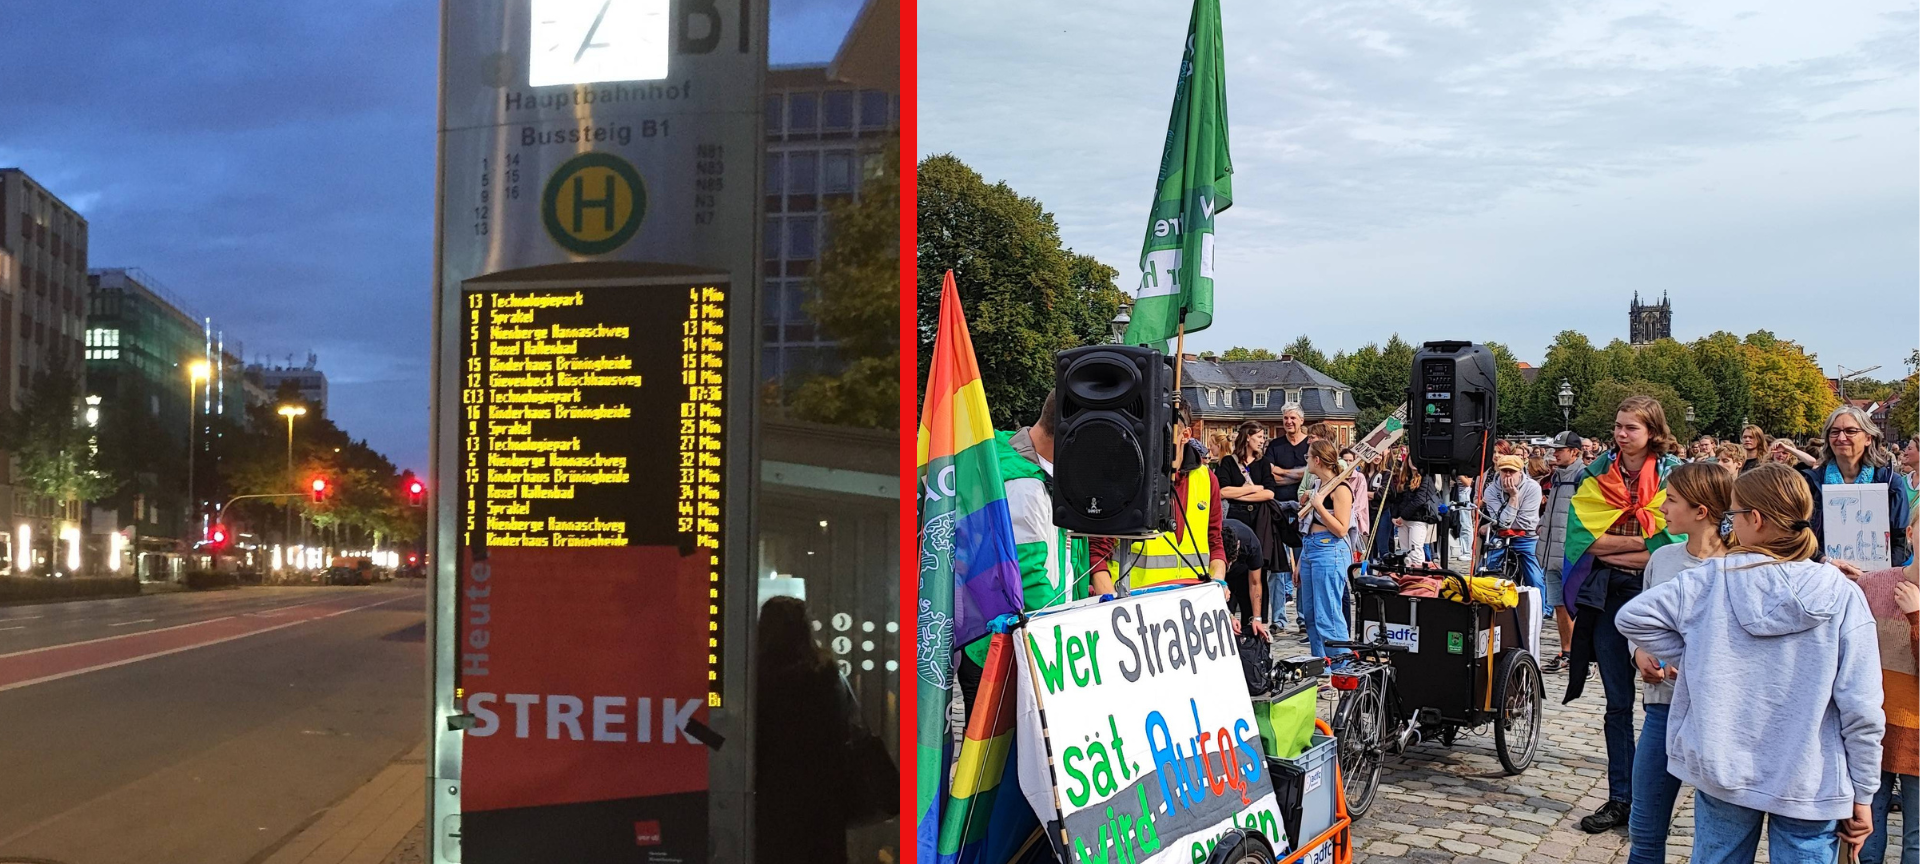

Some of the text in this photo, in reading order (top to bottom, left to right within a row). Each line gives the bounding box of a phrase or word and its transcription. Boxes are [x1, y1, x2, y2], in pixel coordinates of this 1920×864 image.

[505, 81, 692, 111] Hauptbahnhof
[521, 119, 671, 147] Bussteig B1
[483, 158, 488, 171] 1
[505, 153, 520, 167] 14
[482, 173, 489, 187] 5
[505, 169, 520, 183] 15
[504, 186, 519, 199] 16
[475, 206, 489, 219] 12
[573, 175, 615, 233] H
[474, 222, 488, 236] 13
[469, 287, 724, 309] 13 Technologiepark 4 Min
[471, 310, 479, 324] 9
[490, 309, 534, 325] Sprakel
[702, 304, 723, 319] Min
[471, 326, 478, 340] 5
[490, 325, 548, 341] Nienberge
[683, 321, 697, 335] 13
[702, 320, 723, 335] Min
[471, 342, 477, 356] 1
[683, 337, 697, 352] 14
[701, 337, 723, 351] Min
[468, 357, 481, 371] 15
[489, 356, 552, 371] Kinderhaus
[683, 353, 697, 368] 15
[701, 353, 722, 368] Min
[468, 373, 481, 388] 12
[701, 370, 722, 385] Min
[463, 389, 484, 404] E13
[489, 388, 581, 405] Technologiepark
[489, 404, 551, 420] Kinderhaus
[700, 403, 721, 418] Min
[469, 419, 721, 437] 9 Sprakel 25 Min
[466, 437, 480, 451] 13
[488, 436, 581, 452] Technologiepark
[699, 436, 721, 451] Min
[469, 452, 476, 467] 5
[488, 453, 545, 469] Nienberge
[699, 452, 720, 467] Min
[466, 468, 479, 483] 15
[487, 469, 550, 484] Kinderhaus
[680, 468, 694, 483] 33
[698, 468, 720, 483] Min
[468, 484, 474, 498] 1
[698, 485, 720, 499] Min
[468, 500, 475, 515] 9
[487, 500, 530, 516] Sprakel
[698, 501, 719, 516] Min
[1829, 497, 1873, 525] Tu
[468, 516, 475, 530] 5
[487, 516, 544, 532] Nienberge
[698, 518, 719, 532] Min
[1387, 628, 1418, 642] adfc
[1028, 599, 1236, 695] Wer Straßen
[465, 691, 705, 745] STREIK
[1062, 714, 1140, 808] sät,
[1074, 783, 1161, 864] wird
[1314, 841, 1332, 864] adfc
